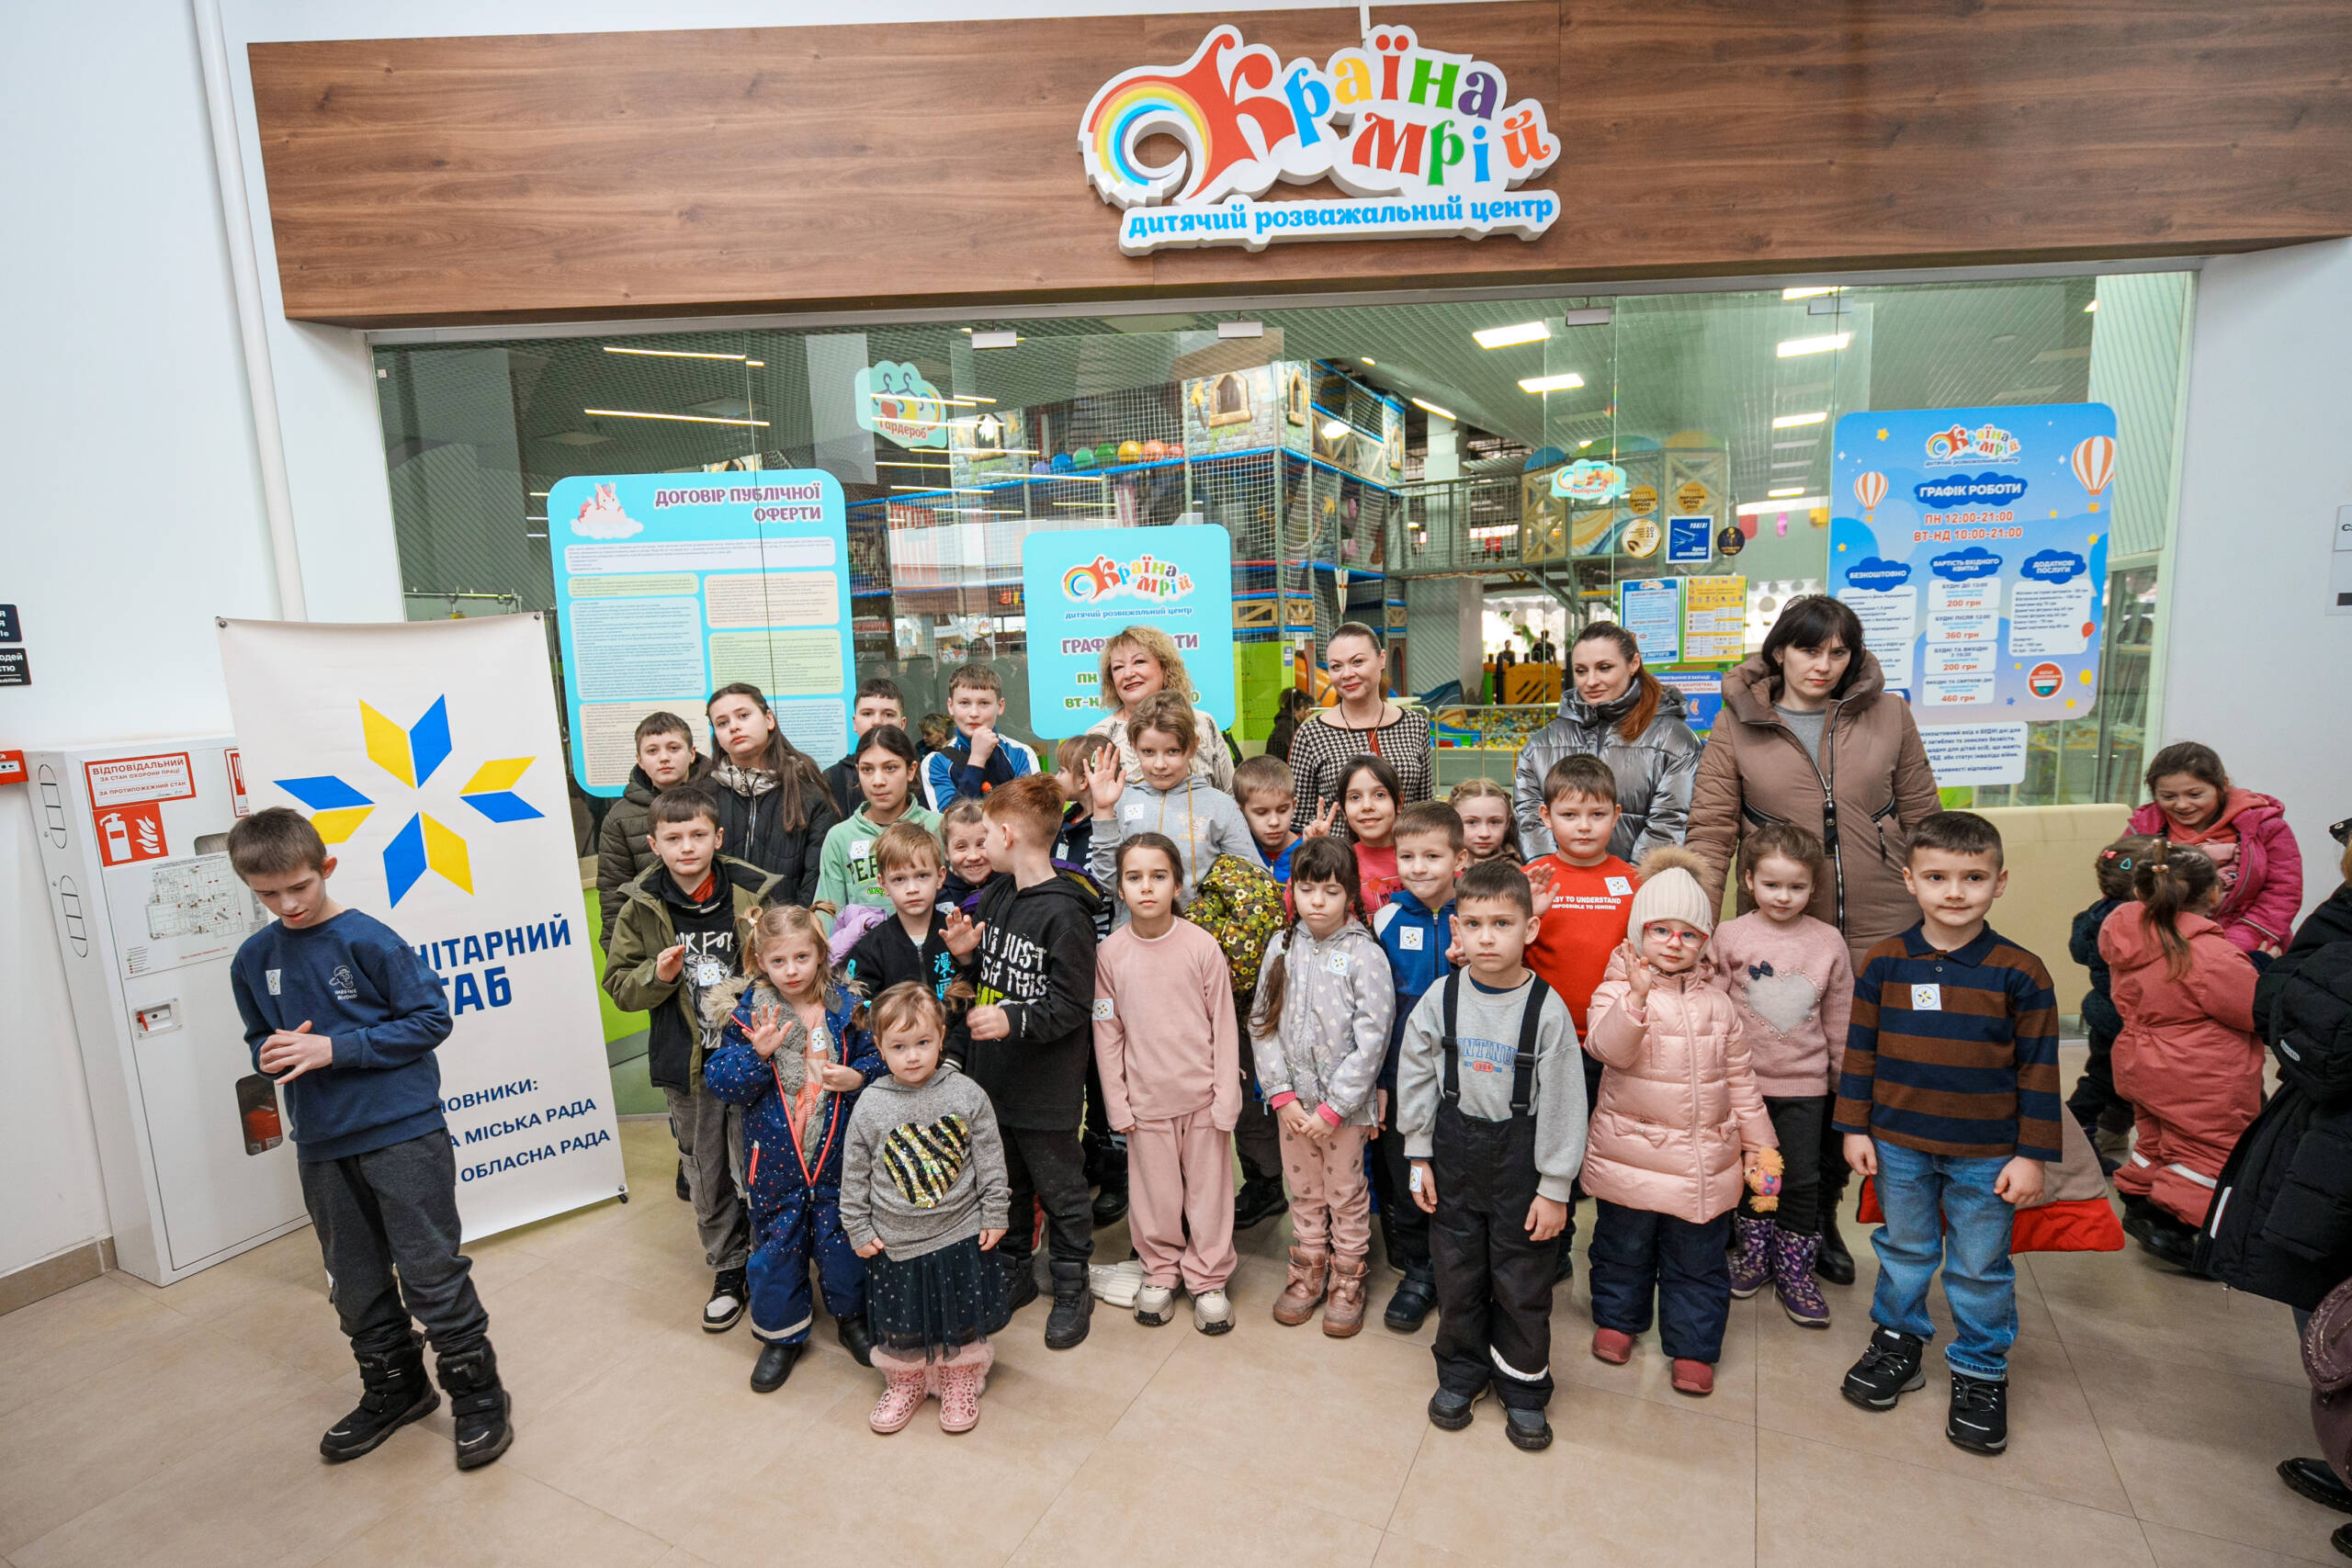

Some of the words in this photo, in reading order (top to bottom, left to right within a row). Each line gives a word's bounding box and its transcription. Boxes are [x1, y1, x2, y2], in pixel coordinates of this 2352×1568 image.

[1148, 34, 1498, 200] Країна
[1351, 109, 1551, 186] мрій
[1129, 204, 1247, 239] дитячий
[1255, 197, 1464, 234] розважальний
[1471, 198, 1554, 224] центр
[655, 488, 726, 506] ДОГОВІР
[729, 482, 821, 502] ПУБЛІЧНОЇ
[1919, 485, 1967, 497] ГРАФІК
[1968, 483, 2021, 495] РОБОТИ
[753, 506, 821, 522] ОФЕРТИ
[1925, 514, 1941, 524] ПН
[1945, 511, 2013, 524] 12:00-21:00
[1914, 530, 1951, 542] ВТ-НД
[1954, 527, 2022, 540] 10:00-21:00
[1849, 570, 1907, 579] БЕЗКОШТОВНО
[1947, 599, 1963, 607] 200
[1065, 610, 1102, 620] дитячий
[1102, 607, 1166, 619] розважальний
[1168, 607, 1193, 616] центр
[1062, 637, 1106, 654] ГРАФ
[1077, 672, 1098, 683] ПН
[1065, 696, 1102, 708] ВТ-Н
[129, 771, 161, 779] ОХОРОНИ
[162, 767, 180, 775] ПРАЦІ
[109, 783, 169, 795] ПРОТИПОЖЕЖНИЙ
[1577, 896, 1622, 904] UNDERSTAND
[418, 913, 571, 971] ІТАРНИЙ
[1001, 932, 1047, 972] JUST
[441, 966, 512, 1016] АБ
[441, 1078, 538, 1113] ОВНИКИ:
[465, 1112, 542, 1145] МІСЬКА
[546, 1098, 597, 1122] РАДА
[460, 1145, 556, 1182] ОБЛАСНА
[560, 1129, 611, 1154] РАДА
